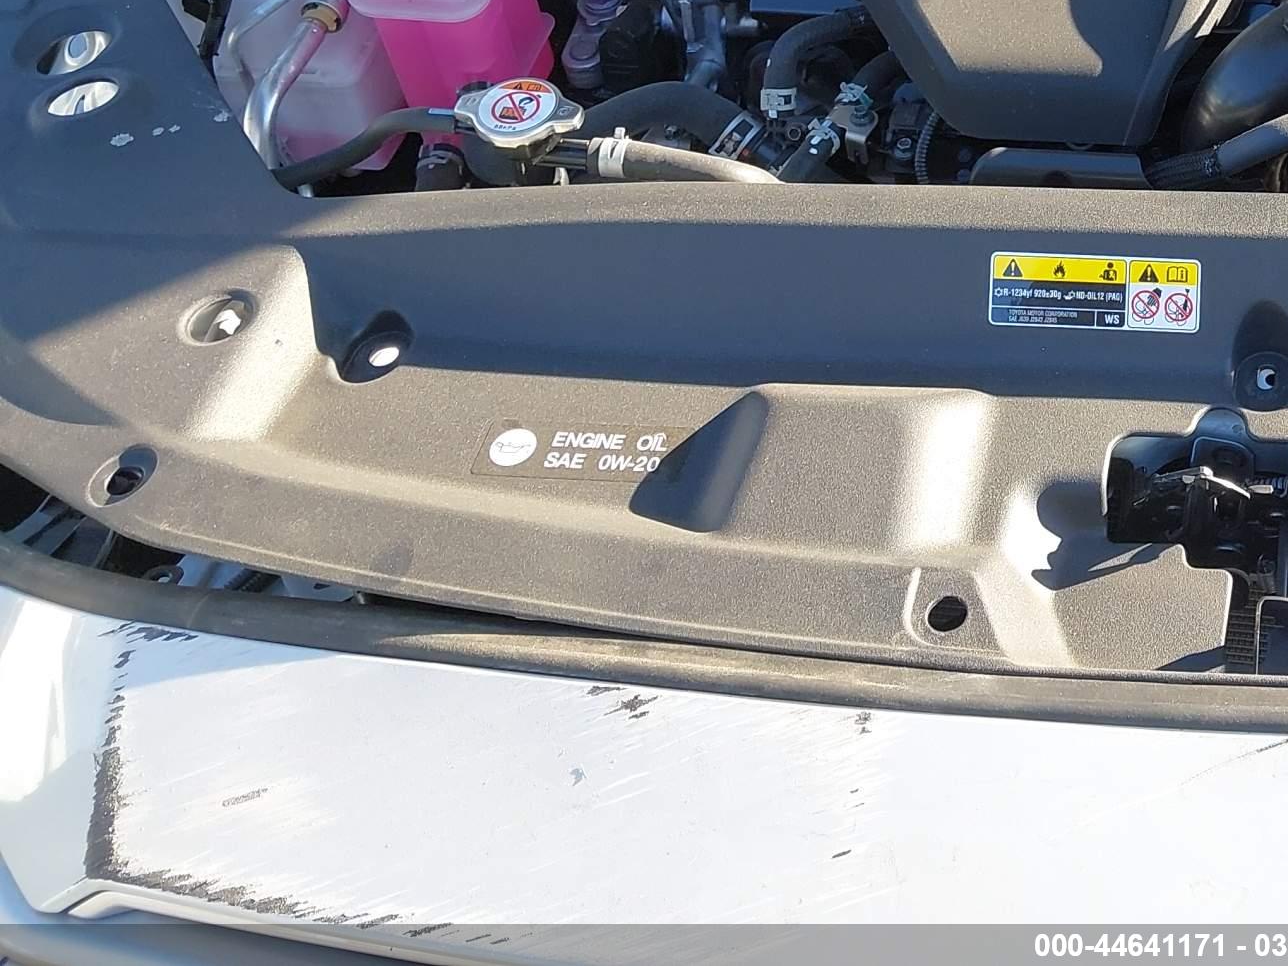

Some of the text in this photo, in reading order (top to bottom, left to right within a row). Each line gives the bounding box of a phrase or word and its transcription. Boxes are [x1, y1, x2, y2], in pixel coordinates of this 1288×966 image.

[1003, 288, 1033, 299] R-1234yf
[1034, 289, 1062, 300] 920±30g
[1105, 292, 1123, 304] (PAG)
[1104, 313, 1120, 325] WS
[551, 431, 668, 452] ENGINE OIL
[543, 451, 661, 473] SAE 0W-20
